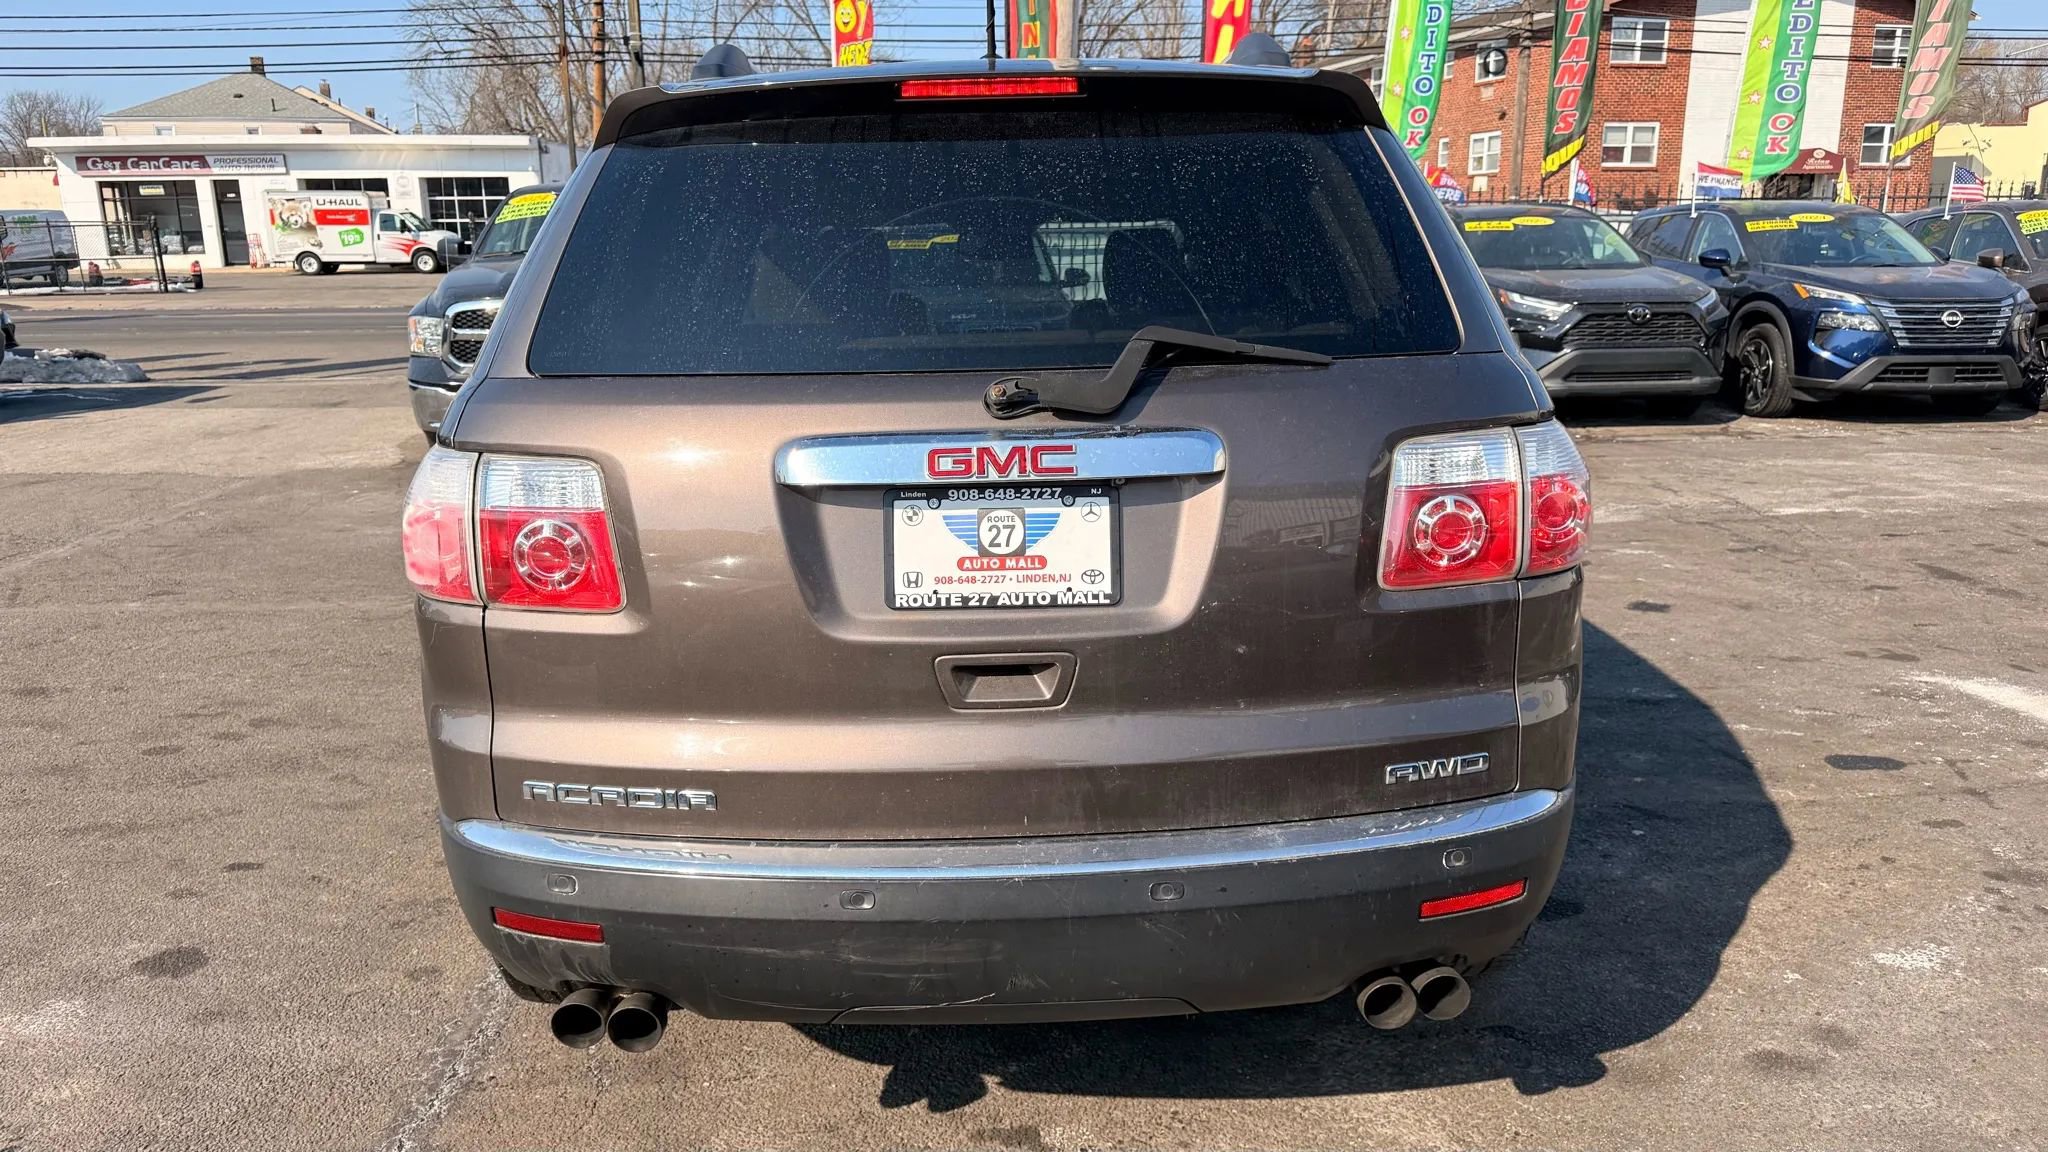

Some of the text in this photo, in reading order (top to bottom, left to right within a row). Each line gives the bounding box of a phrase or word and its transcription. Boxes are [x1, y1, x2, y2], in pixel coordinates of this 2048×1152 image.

[1414, 5, 1444, 95] DITO
[1405, 107, 1429, 147] OK
[1765, 113, 1795, 154] OK
[127, 156, 201, 171] CarCare
[213, 157, 279, 165] PROFESSIONAL
[1698, 175, 1740, 186] WE FINANCE
[316, 198, 363, 206] U-HAUL
[926, 444, 1079, 480] GMC
[948, 487, 1062, 501] 908-648-2727
[986, 515, 1016, 524] ROUTE
[987, 524, 1016, 549] 27
[962, 558, 1041, 570] AUTO MALL
[934, 573, 1072, 585] 908-648-2727 LINDEN,NJ
[895, 591, 1110, 607] ROUTE 27 AUTO MALL
[1385, 752, 1489, 784] AWD
[522, 780, 718, 811] ACADIA
